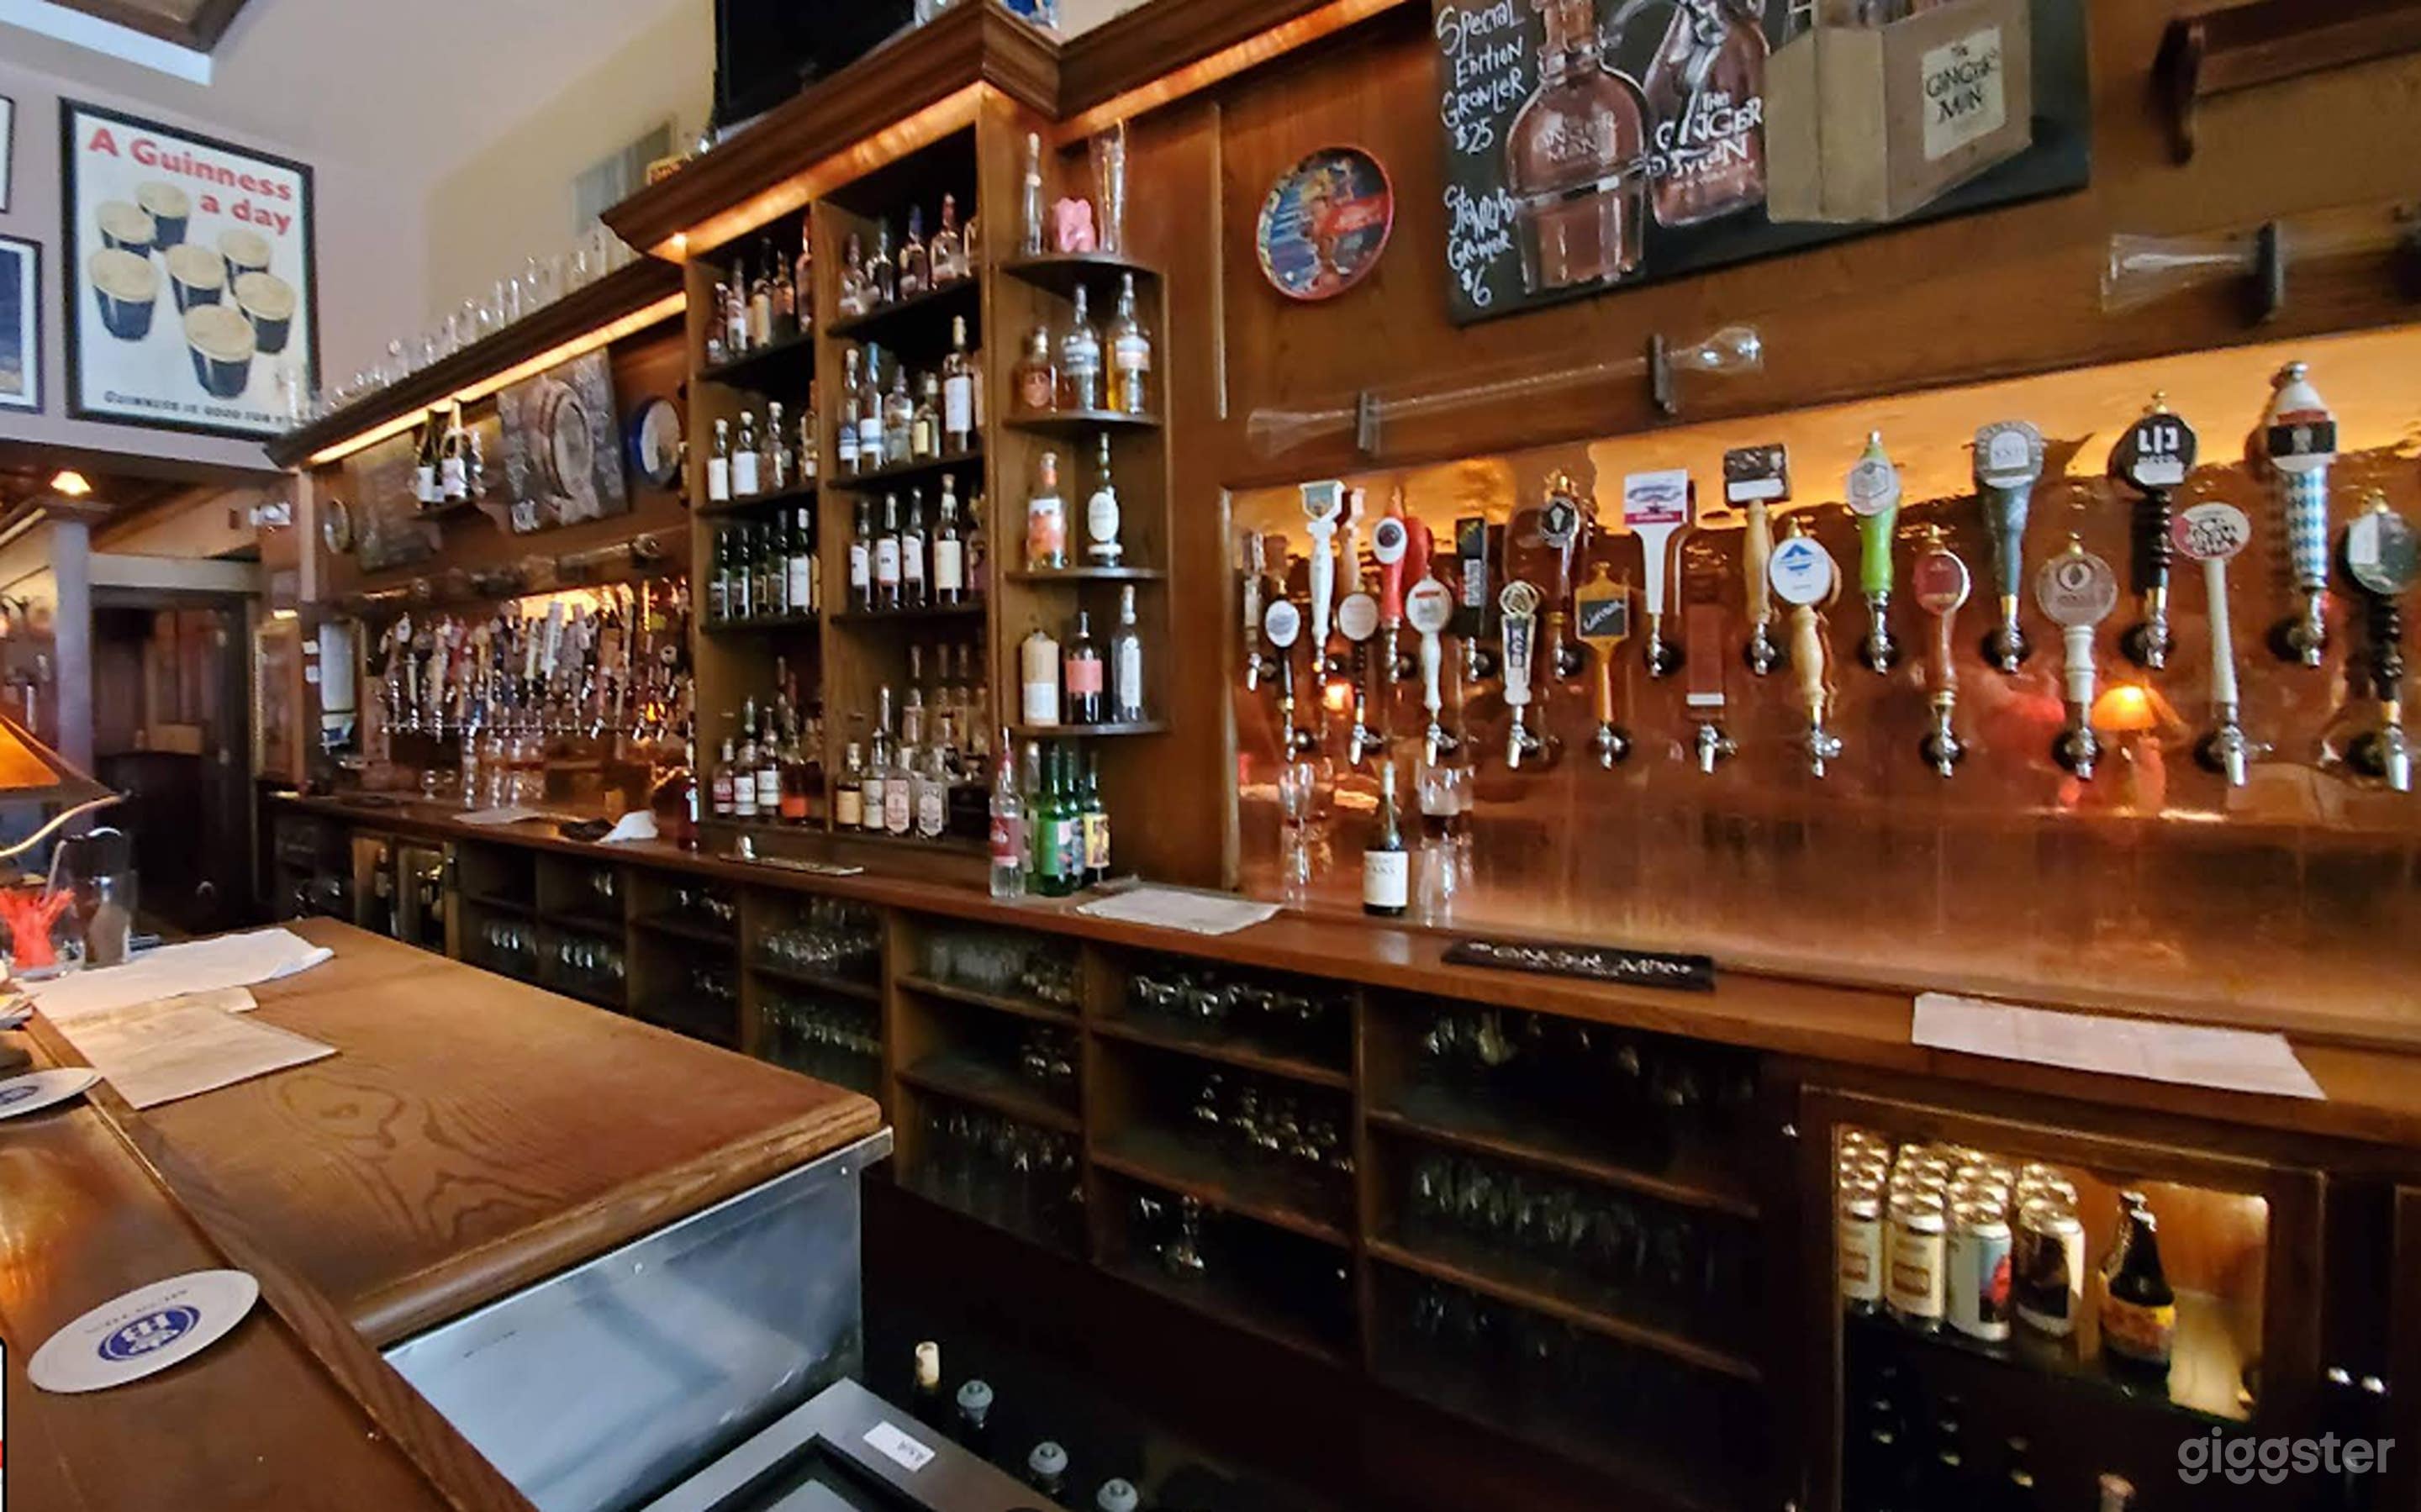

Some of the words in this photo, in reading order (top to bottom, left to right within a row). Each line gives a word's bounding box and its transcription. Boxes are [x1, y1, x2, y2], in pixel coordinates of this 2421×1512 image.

[87, 128, 118, 157] A
[129, 139, 293, 201] Guinness
[201, 194, 220, 214] a
[232, 198, 293, 235] day
